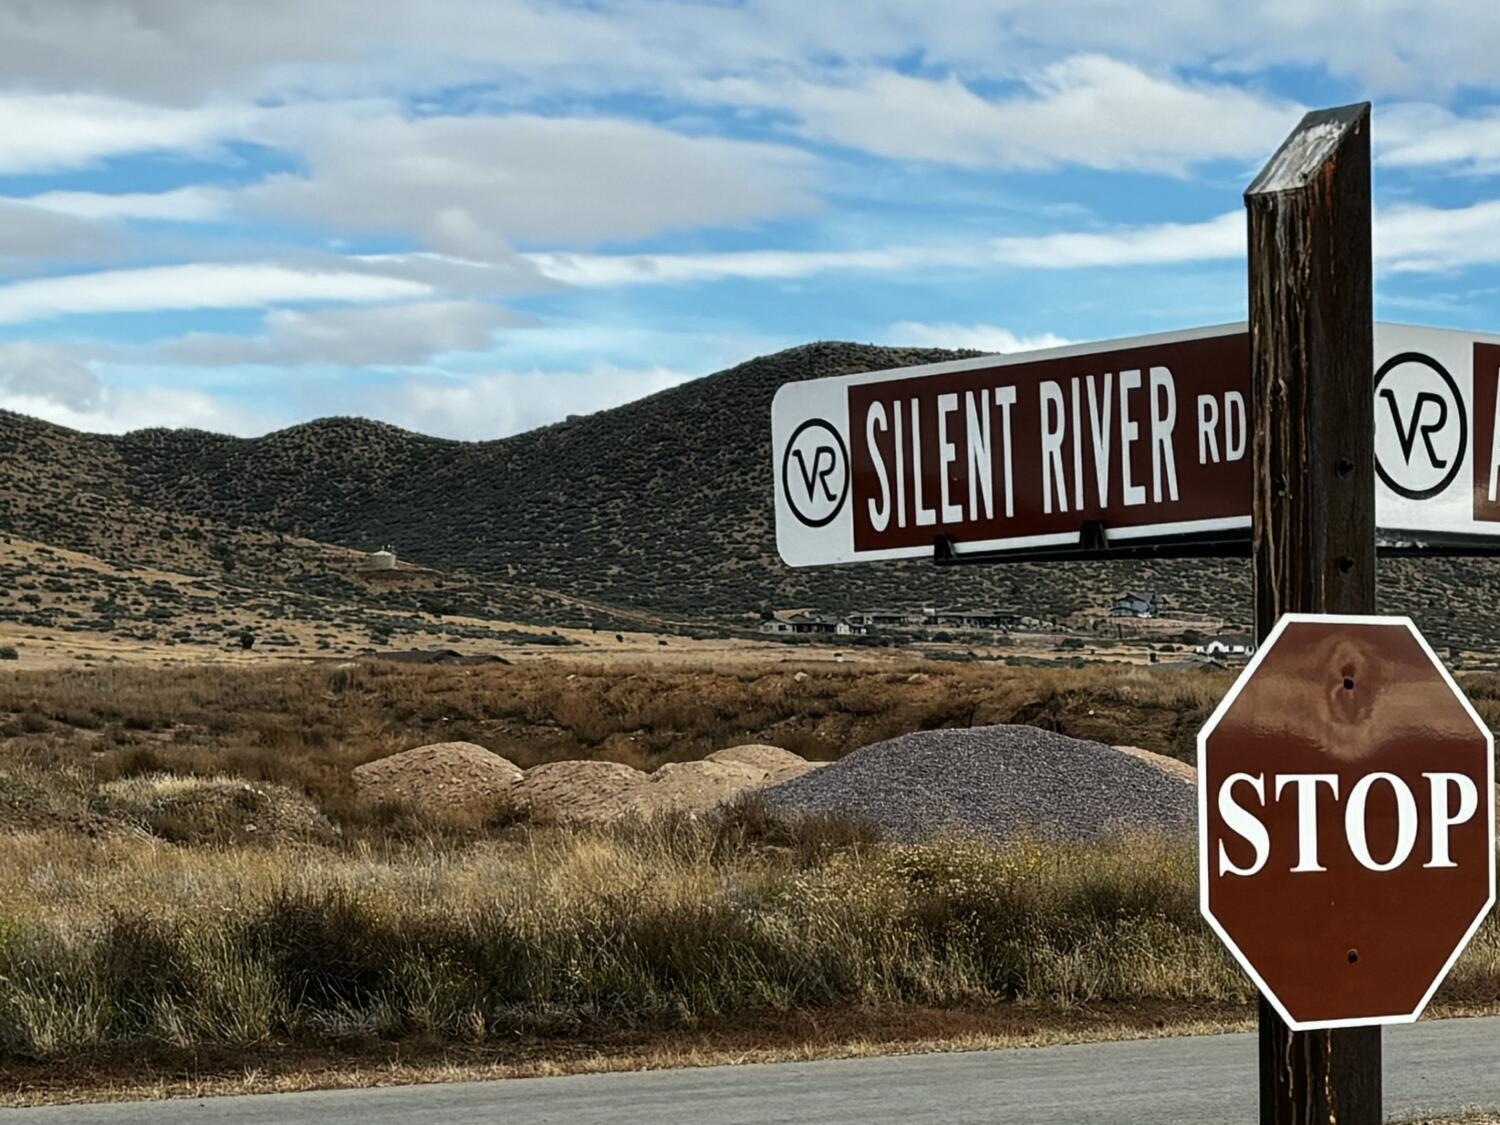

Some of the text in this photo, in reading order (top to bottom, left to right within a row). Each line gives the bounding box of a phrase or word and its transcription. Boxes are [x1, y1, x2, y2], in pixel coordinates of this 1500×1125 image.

[792, 445, 838, 502] VR
[866, 366, 1247, 533] SILENT RIVER RD
[1379, 388, 1448, 469] VR
[1217, 771, 1479, 878] STOP
